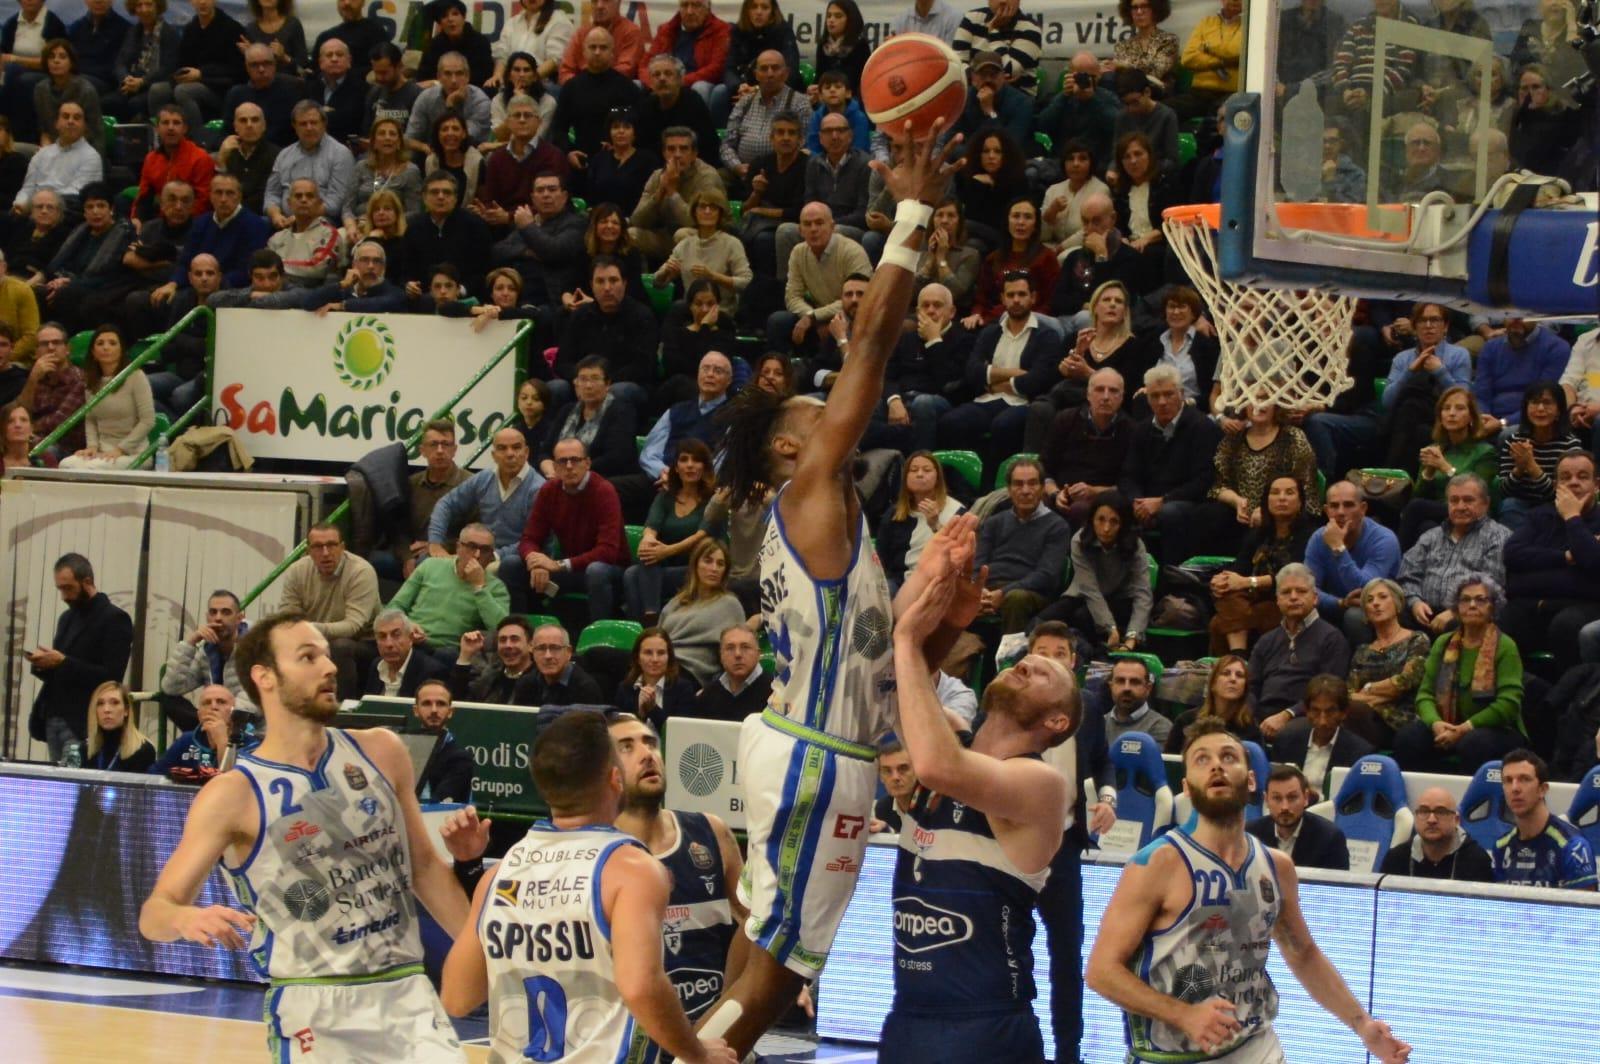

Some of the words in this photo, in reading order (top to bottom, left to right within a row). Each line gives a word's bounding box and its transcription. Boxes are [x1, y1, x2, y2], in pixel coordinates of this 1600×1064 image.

[492, 742, 511, 768] di
[1121, 741, 1142, 753] OMP
[1360, 762, 1382, 775] OMP
[270, 777, 304, 817] 2
[471, 776, 523, 798] Gruppo
[329, 855, 389, 889] Banco
[525, 876, 589, 897] REALE
[1194, 869, 1231, 906] 22
[522, 893, 582, 910] MUTUA
[891, 911, 955, 937] ompea
[486, 920, 595, 962] SPISSU
[907, 958, 933, 971] stress
[523, 974, 567, 1061] 0
